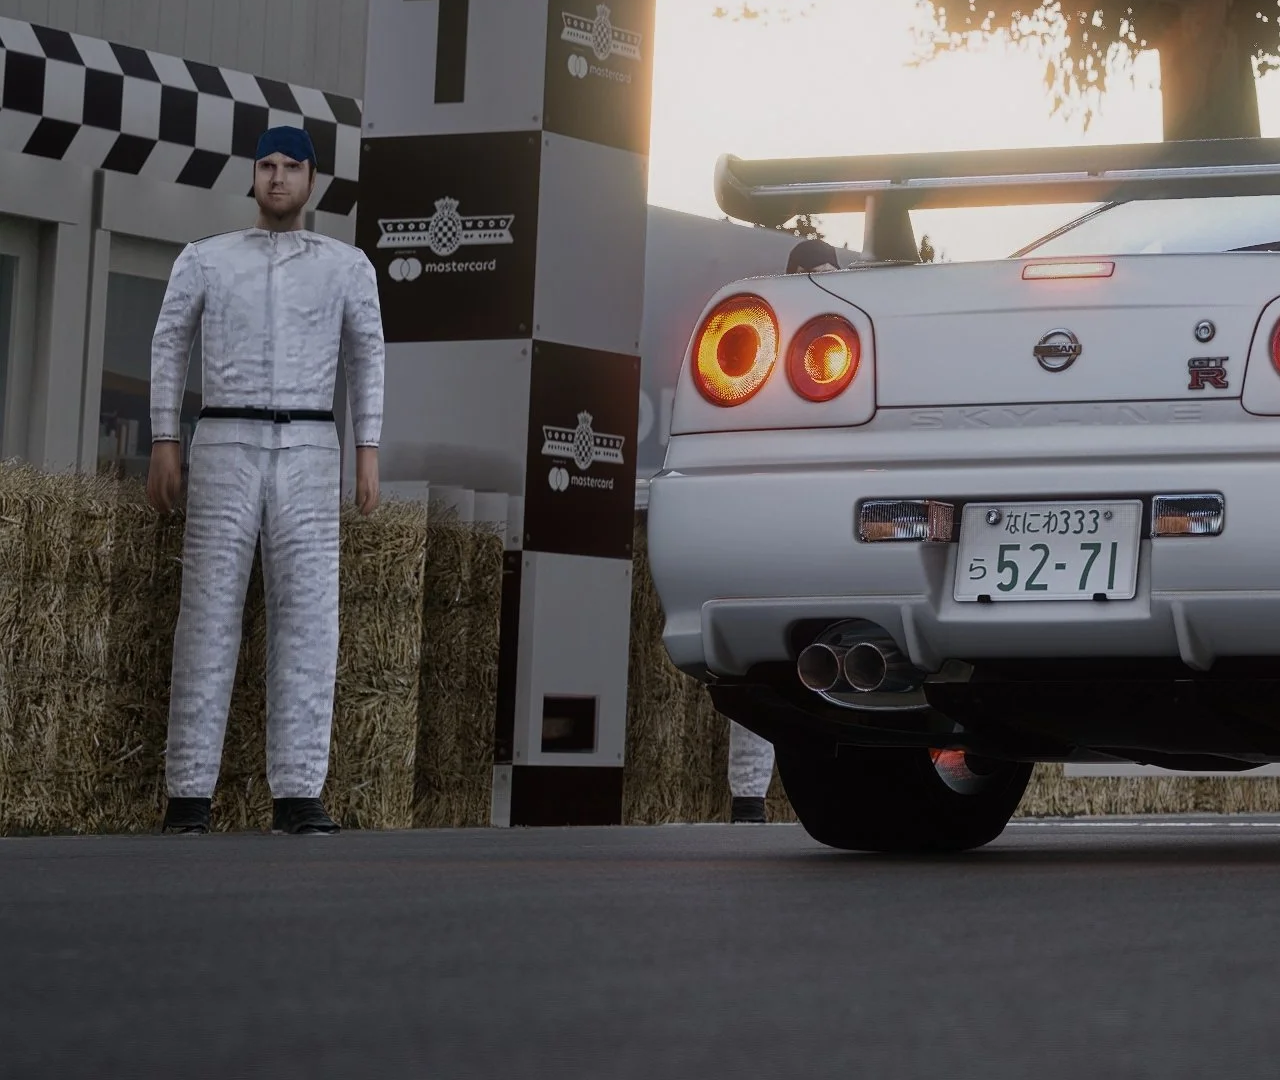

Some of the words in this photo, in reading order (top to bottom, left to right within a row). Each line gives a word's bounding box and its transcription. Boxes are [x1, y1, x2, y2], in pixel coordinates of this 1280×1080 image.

[589, 64, 632, 84] mastercard
[425, 258, 497, 273] mastercard
[910, 404, 1203, 430] SKYLINE
[570, 476, 614, 490] mastercard
[969, 558, 988, 580] ら
[996, 541, 1118, 592] 52-71
